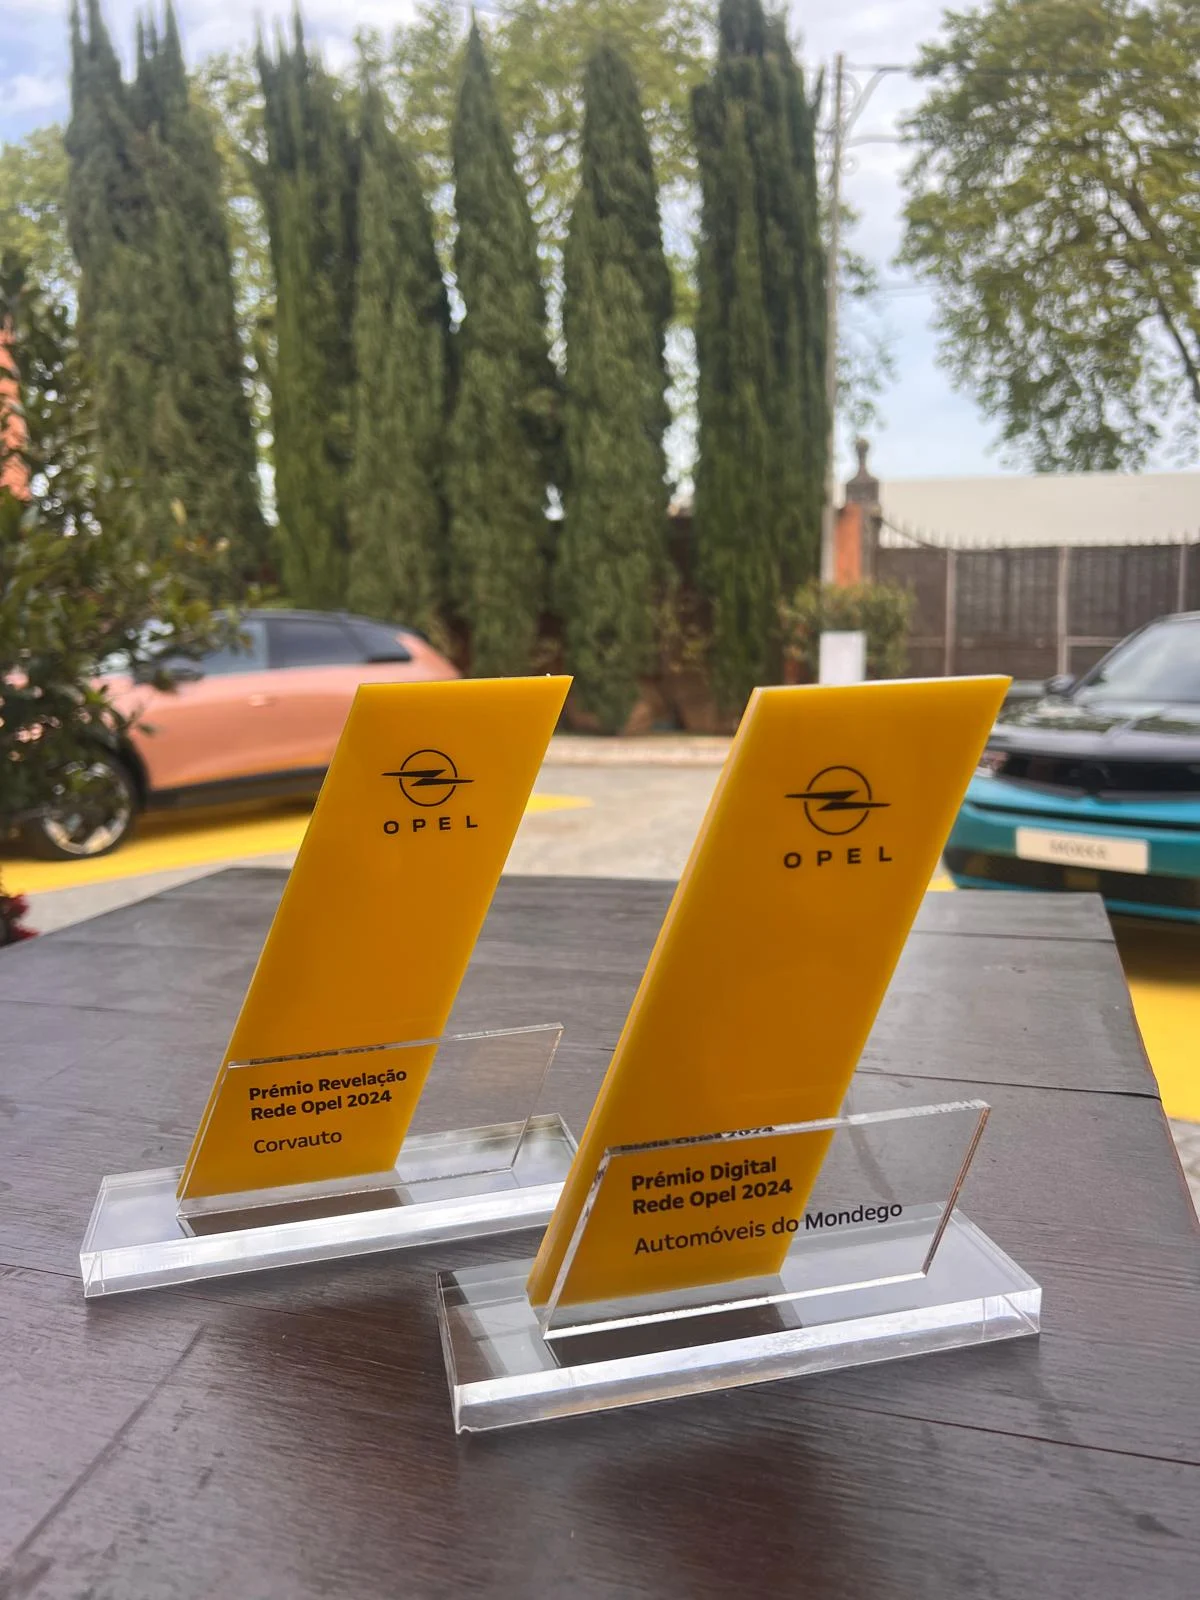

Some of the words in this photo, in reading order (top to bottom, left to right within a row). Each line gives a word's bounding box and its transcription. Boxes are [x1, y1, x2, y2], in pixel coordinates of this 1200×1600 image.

[383, 815, 478, 835] OPEL
[783, 846, 892, 869] OPEL
[249, 1081, 314, 1101] Prémio
[318, 1069, 408, 1093] Revelação
[251, 1103, 297, 1121] Rede
[301, 1096, 343, 1115] Opel
[347, 1090, 392, 1108] 2024
[253, 1130, 342, 1154] Corvauto
[631, 1169, 705, 1191] Prémio
[710, 1157, 777, 1182] Digital
[633, 1197, 684, 1215] Rede
[689, 1186, 736, 1209] Opel
[741, 1178, 793, 1201] 2024
[634, 1220, 766, 1255] Automóveis
[772, 1217, 799, 1235] do
[805, 1203, 903, 1231] Mondego
